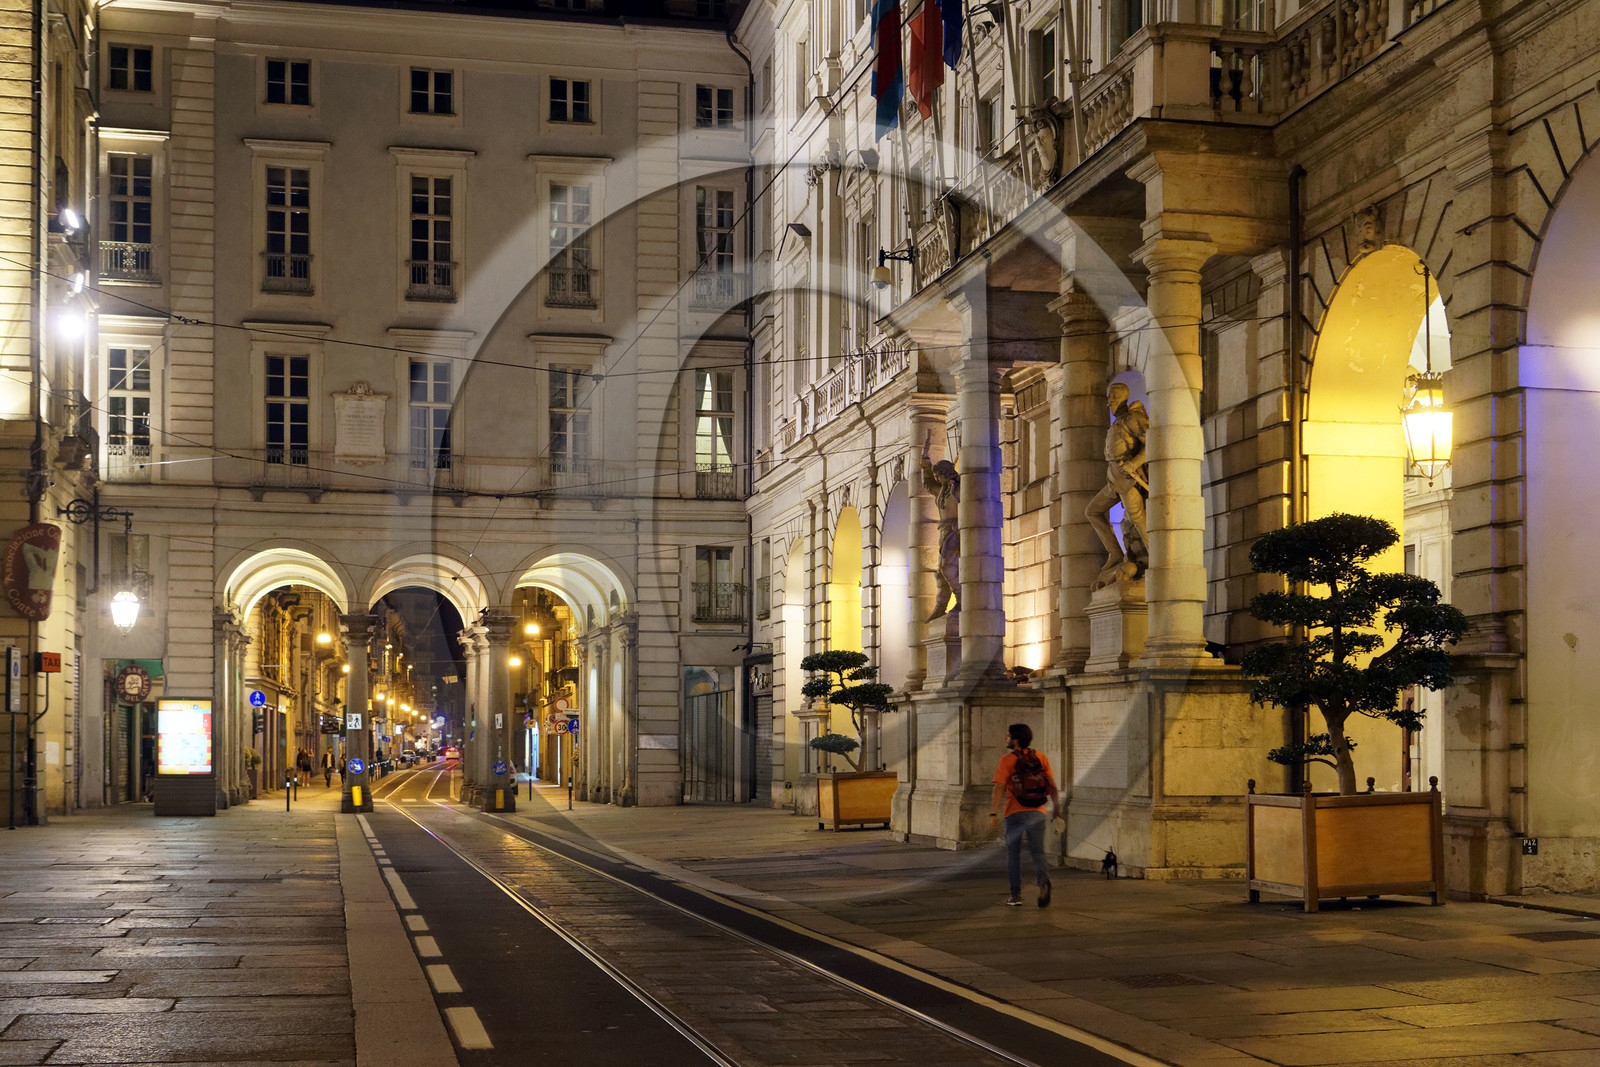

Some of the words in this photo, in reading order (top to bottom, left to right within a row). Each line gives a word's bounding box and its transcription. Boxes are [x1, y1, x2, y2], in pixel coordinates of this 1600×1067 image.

[5, 528, 45, 582] Associazione
[8, 589, 36, 617] Conte
[44, 657, 60, 667] TAXI
[126, 667, 142, 675] BAR
[117, 674, 126, 694] CASA
[125, 694, 140, 702] DEL
